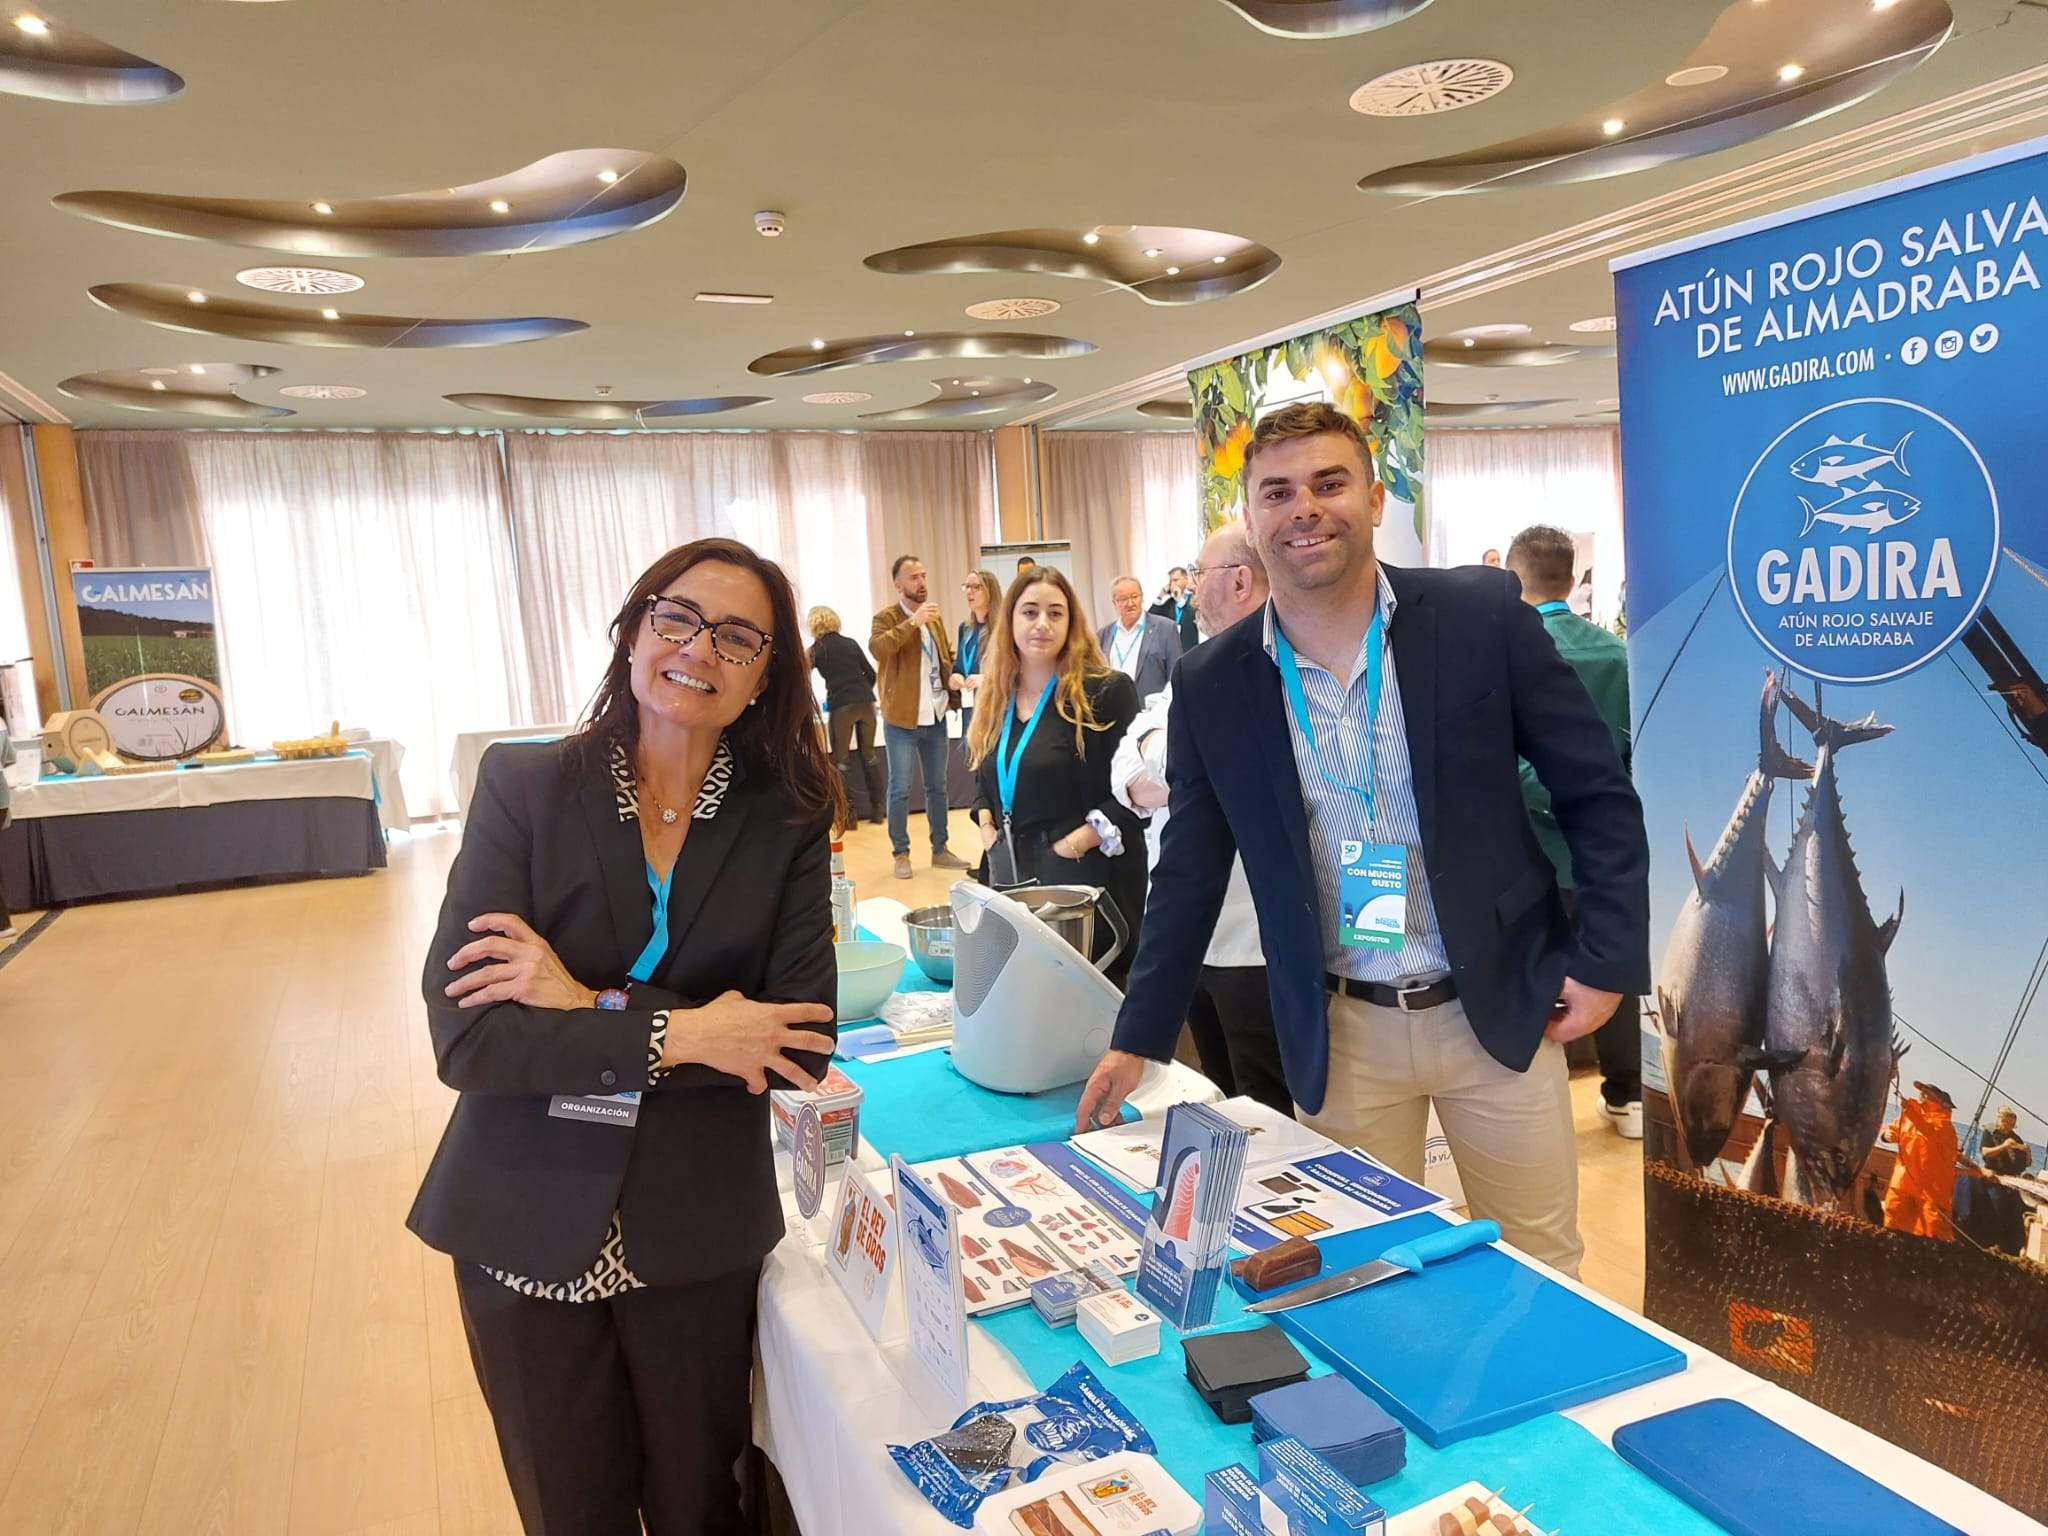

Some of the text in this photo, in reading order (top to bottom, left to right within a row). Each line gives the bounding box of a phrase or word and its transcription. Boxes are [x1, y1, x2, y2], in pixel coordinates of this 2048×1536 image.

[1652, 267, 1754, 328] ATÚN
[1768, 237, 1884, 300] ROJO
[1697, 249, 2043, 360] DE ALMADRABA
[1722, 347, 1875, 396] WWW.GADIRA.COM
[1756, 537, 1963, 606] GADIRA
[1778, 611, 1934, 629] ATÚN ROJO SALVAJE
[1795, 631, 1914, 647] DE ALMADRABA
[1346, 867, 1402, 880] CON MUCHO
[1371, 879, 1402, 889] GUSTO
[560, 1102, 630, 1118] ORGANIZACIÓN
[861, 1195, 887, 1238] EL REY
[857, 1218, 886, 1274] DE OROS
